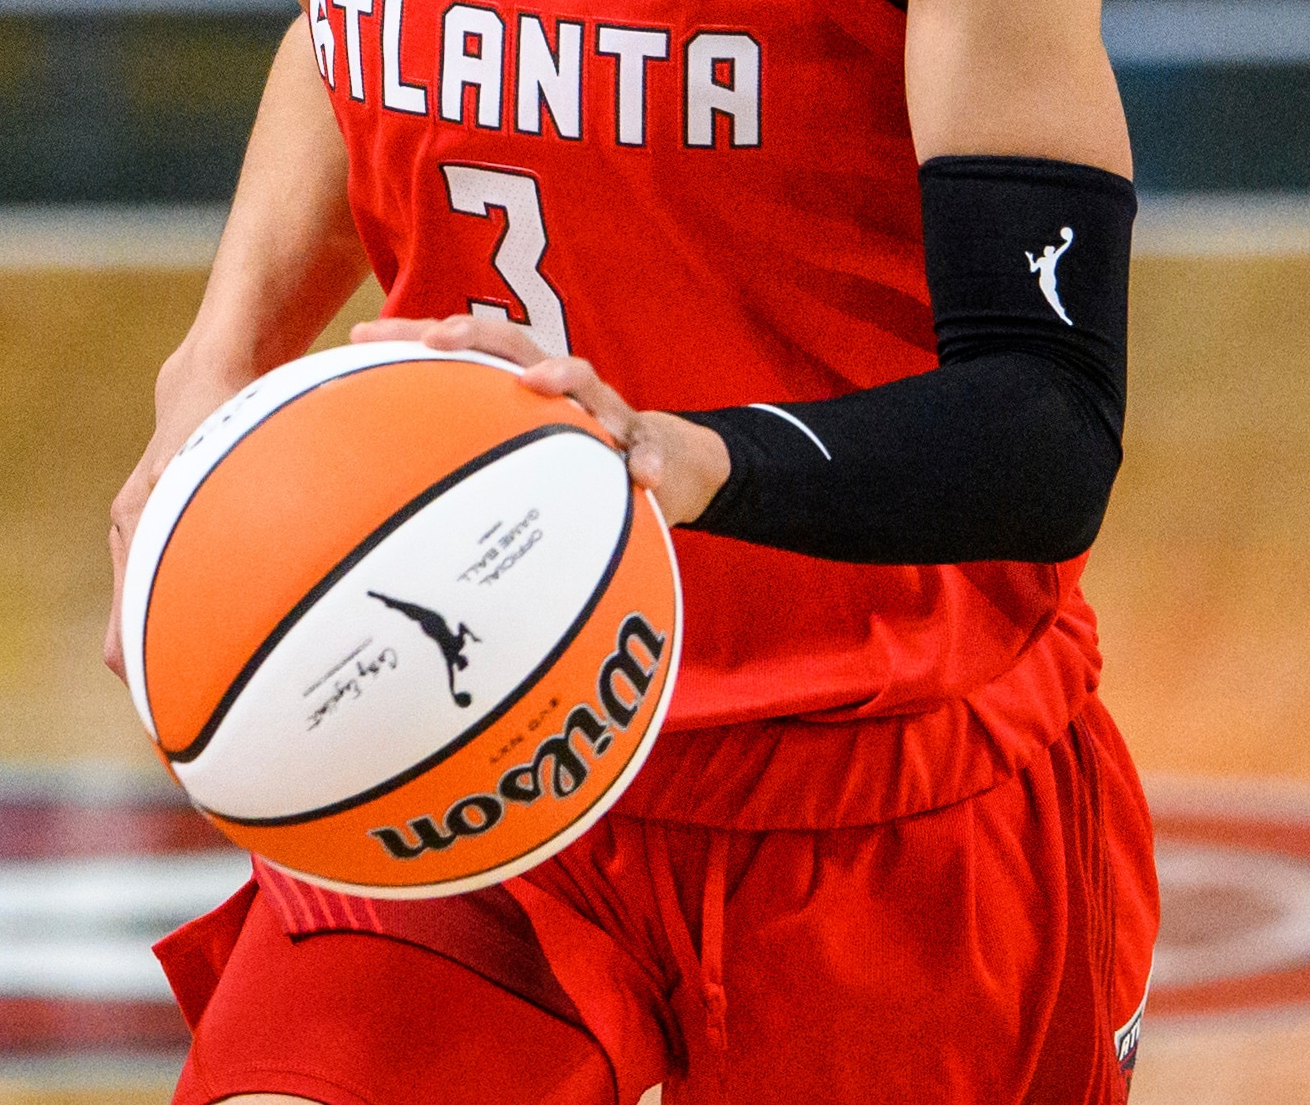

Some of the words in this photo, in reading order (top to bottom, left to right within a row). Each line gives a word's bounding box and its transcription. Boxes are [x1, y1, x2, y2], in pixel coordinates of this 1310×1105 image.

[439, 163, 573, 358] 3
[456, 547, 500, 582] BALL
[498, 508, 540, 550] GAME
[368, 611, 667, 861] Wilson
